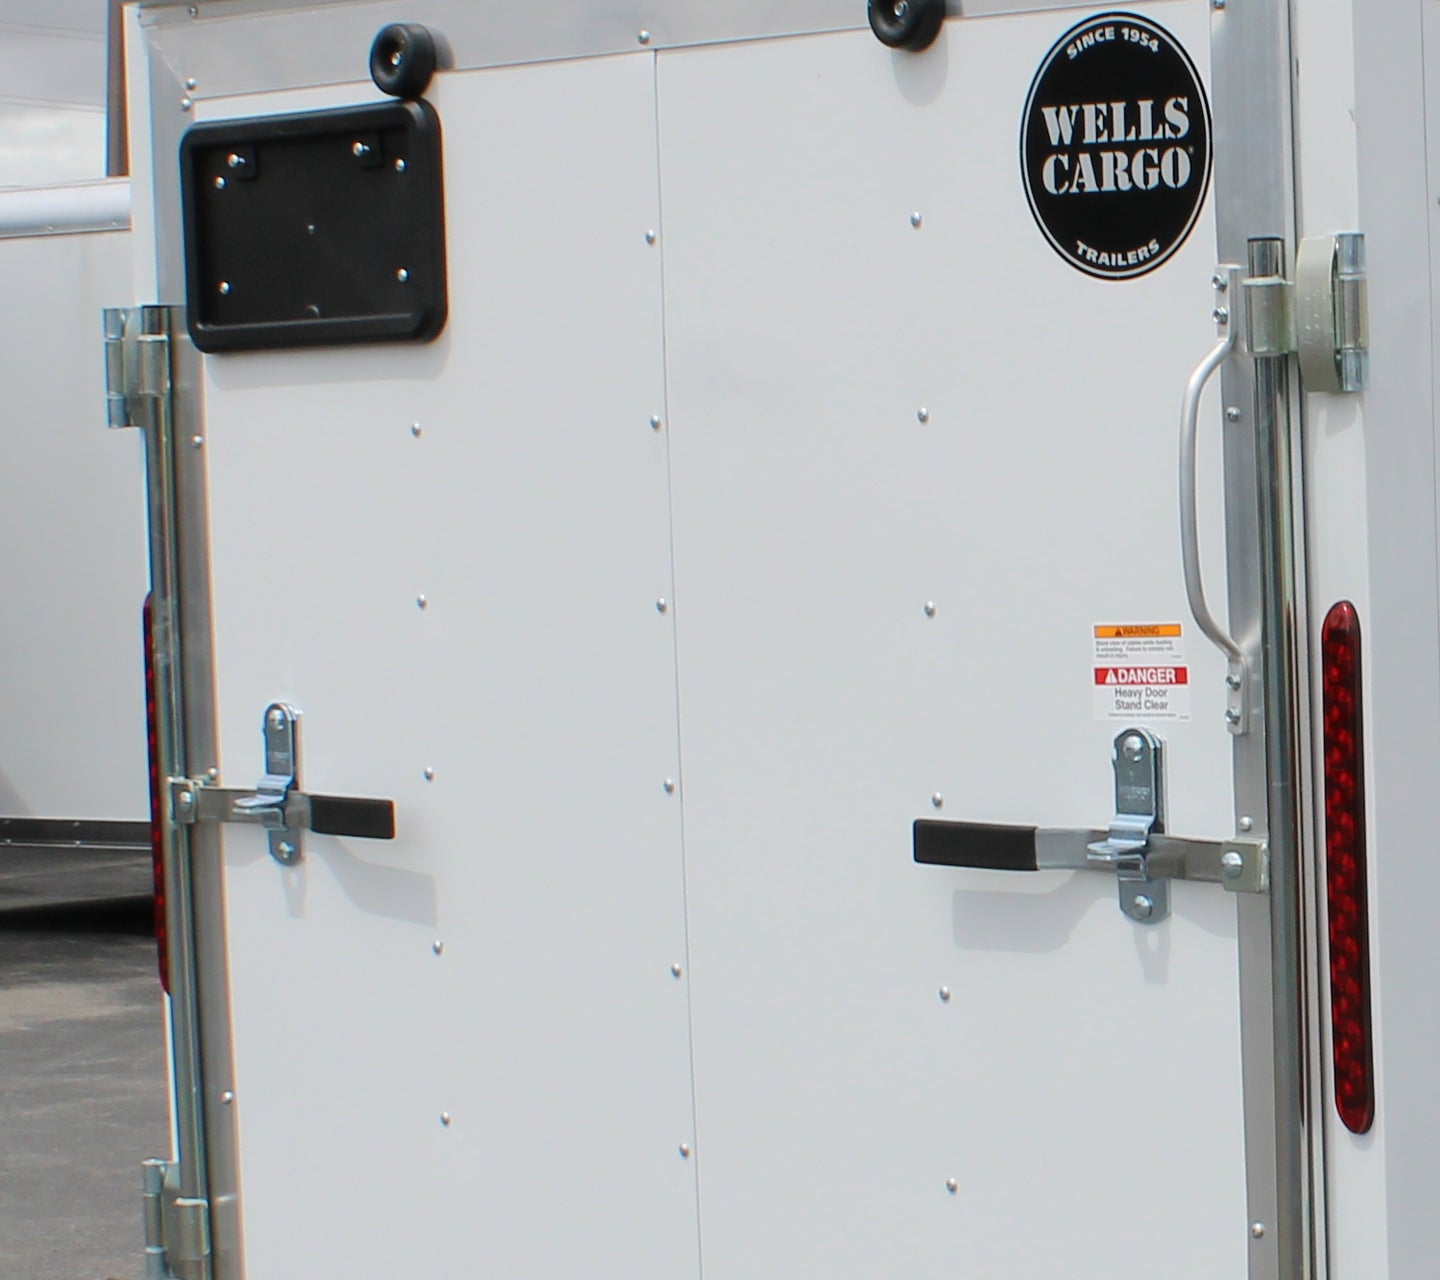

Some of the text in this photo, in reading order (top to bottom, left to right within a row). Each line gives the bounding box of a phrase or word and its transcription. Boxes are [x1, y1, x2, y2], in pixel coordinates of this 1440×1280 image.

[1066, 26, 1161, 60] SINCE 1954
[1041, 96, 1190, 146] WELLS
[1041, 147, 1192, 196] CARGO
[1075, 239, 1160, 267] TRAILERS
[1122, 626, 1160, 636] WARNING
[1118, 668, 1177, 684] DANGER
[1114, 686, 1169, 699] Heavy Door
[1115, 699, 1169, 711] Stand Clear
